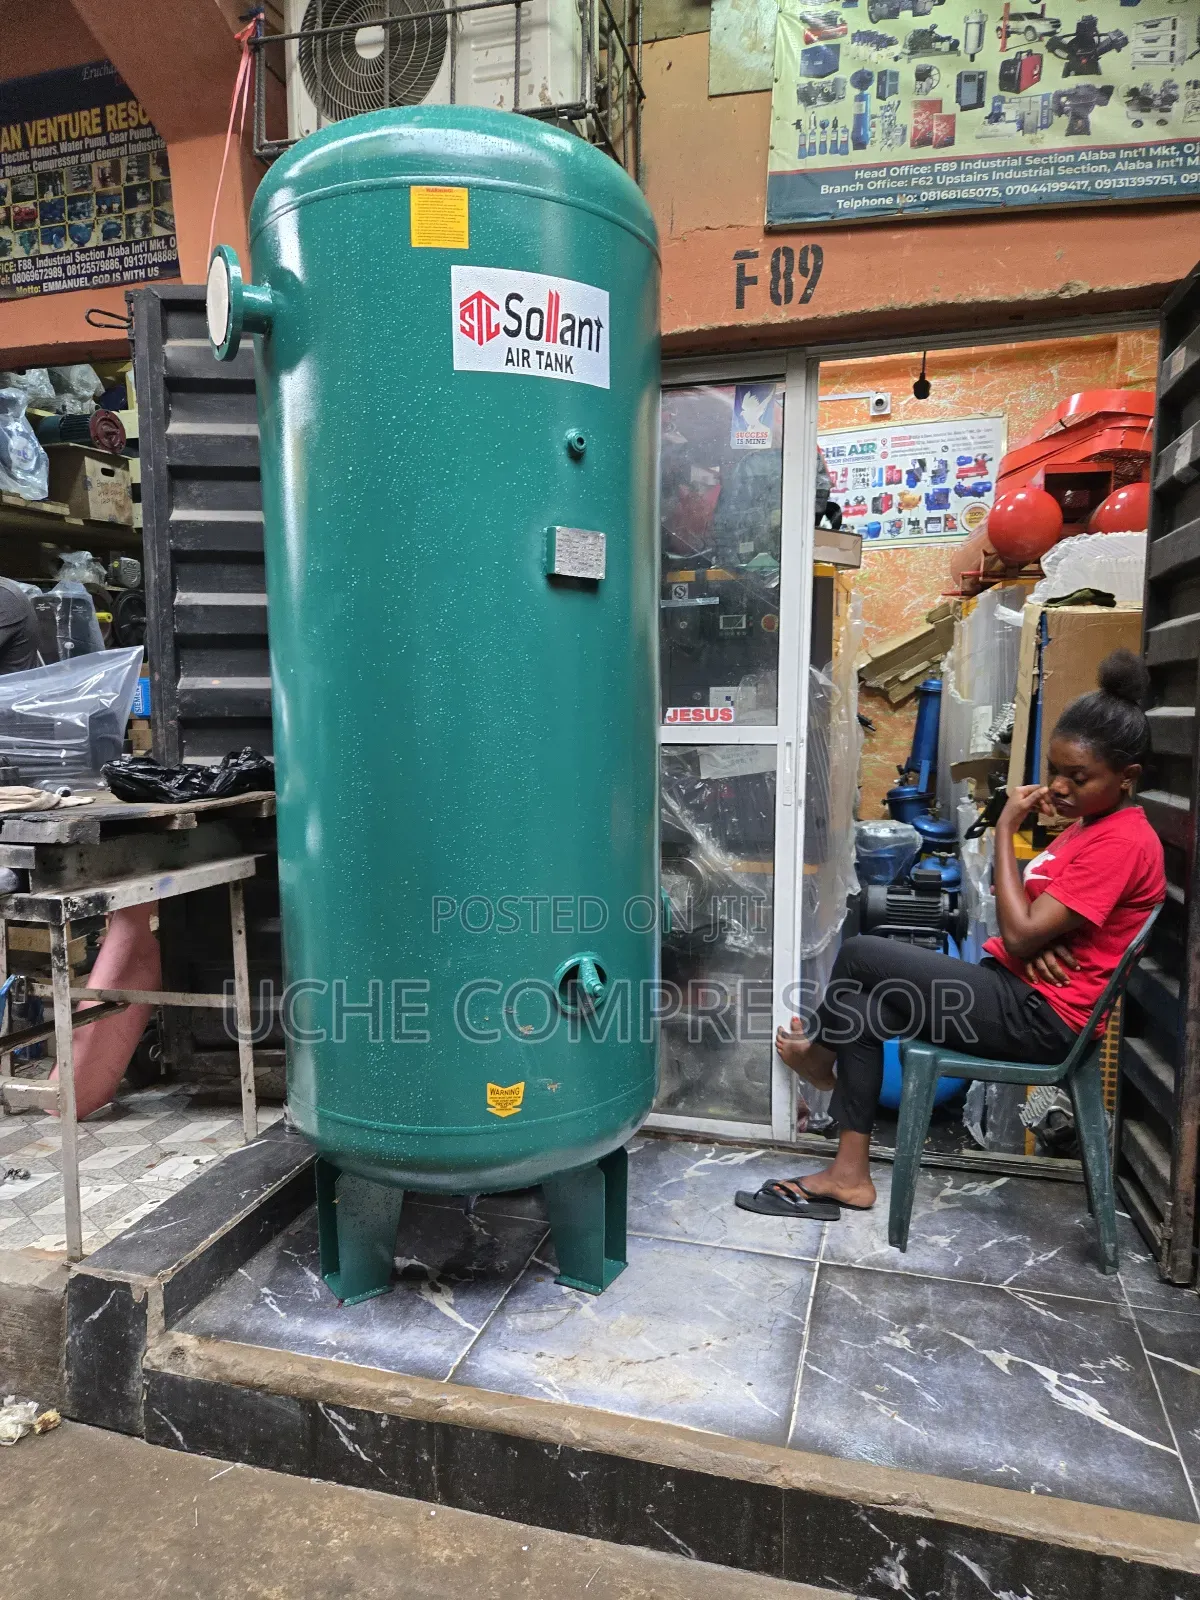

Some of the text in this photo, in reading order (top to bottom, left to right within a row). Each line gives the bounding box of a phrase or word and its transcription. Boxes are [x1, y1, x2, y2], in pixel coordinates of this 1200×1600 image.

[24, 107, 102, 148] VENTURE
[1, 149, 30, 165] Electric
[60, 140, 84, 154] Water
[109, 131, 128, 144] Gear
[33, 155, 79, 172] Compressor
[80, 151, 96, 163] and
[97, 145, 128, 160] General
[820, 181, 864, 195] Branch
[866, 178, 908, 191] Office:
[910, 176, 933, 188] F62
[936, 170, 989, 188] Upstairs
[991, 167, 1054, 181] Industrial
[1057, 163, 1111, 176] Section,
[1113, 158, 1153, 171] Alaba
[854, 167, 887, 180] Head
[889, 164, 931, 177] Office:
[934, 161, 957, 173] F89
[960, 153, 1022, 170] Industrial
[1024, 151, 1075, 166] Section
[1078, 147, 1116, 162] Alaba
[1119, 146, 1145, 159] Int'l
[1149, 145, 1180, 157] Mkt,
[836, 194, 893, 210] Telphone
[919, 182, 1003, 202] 08168165075,
[1005, 178, 1092, 196] 07044199417,
[1094, 174, 1177, 190] 09131395751,
[18, 258, 35, 271] F88,
[36, 252, 73, 268] Industrial
[75, 248, 105, 262] Section
[107, 244, 130, 258] Alaba
[16, 266, 160, 294] Motto: EMMANUEL GOD IS WITH US
[732, 243, 824, 309] F 89
[503, 288, 604, 353] Sollant
[505, 347, 574, 374] AIR TANK
[735, 431, 769, 439] SUCCESS
[821, 445, 847, 459] HE
[848, 442, 877, 456] AIR
[667, 708, 733, 722] JESUS
[490, 1087, 520, 1096] WARNING
